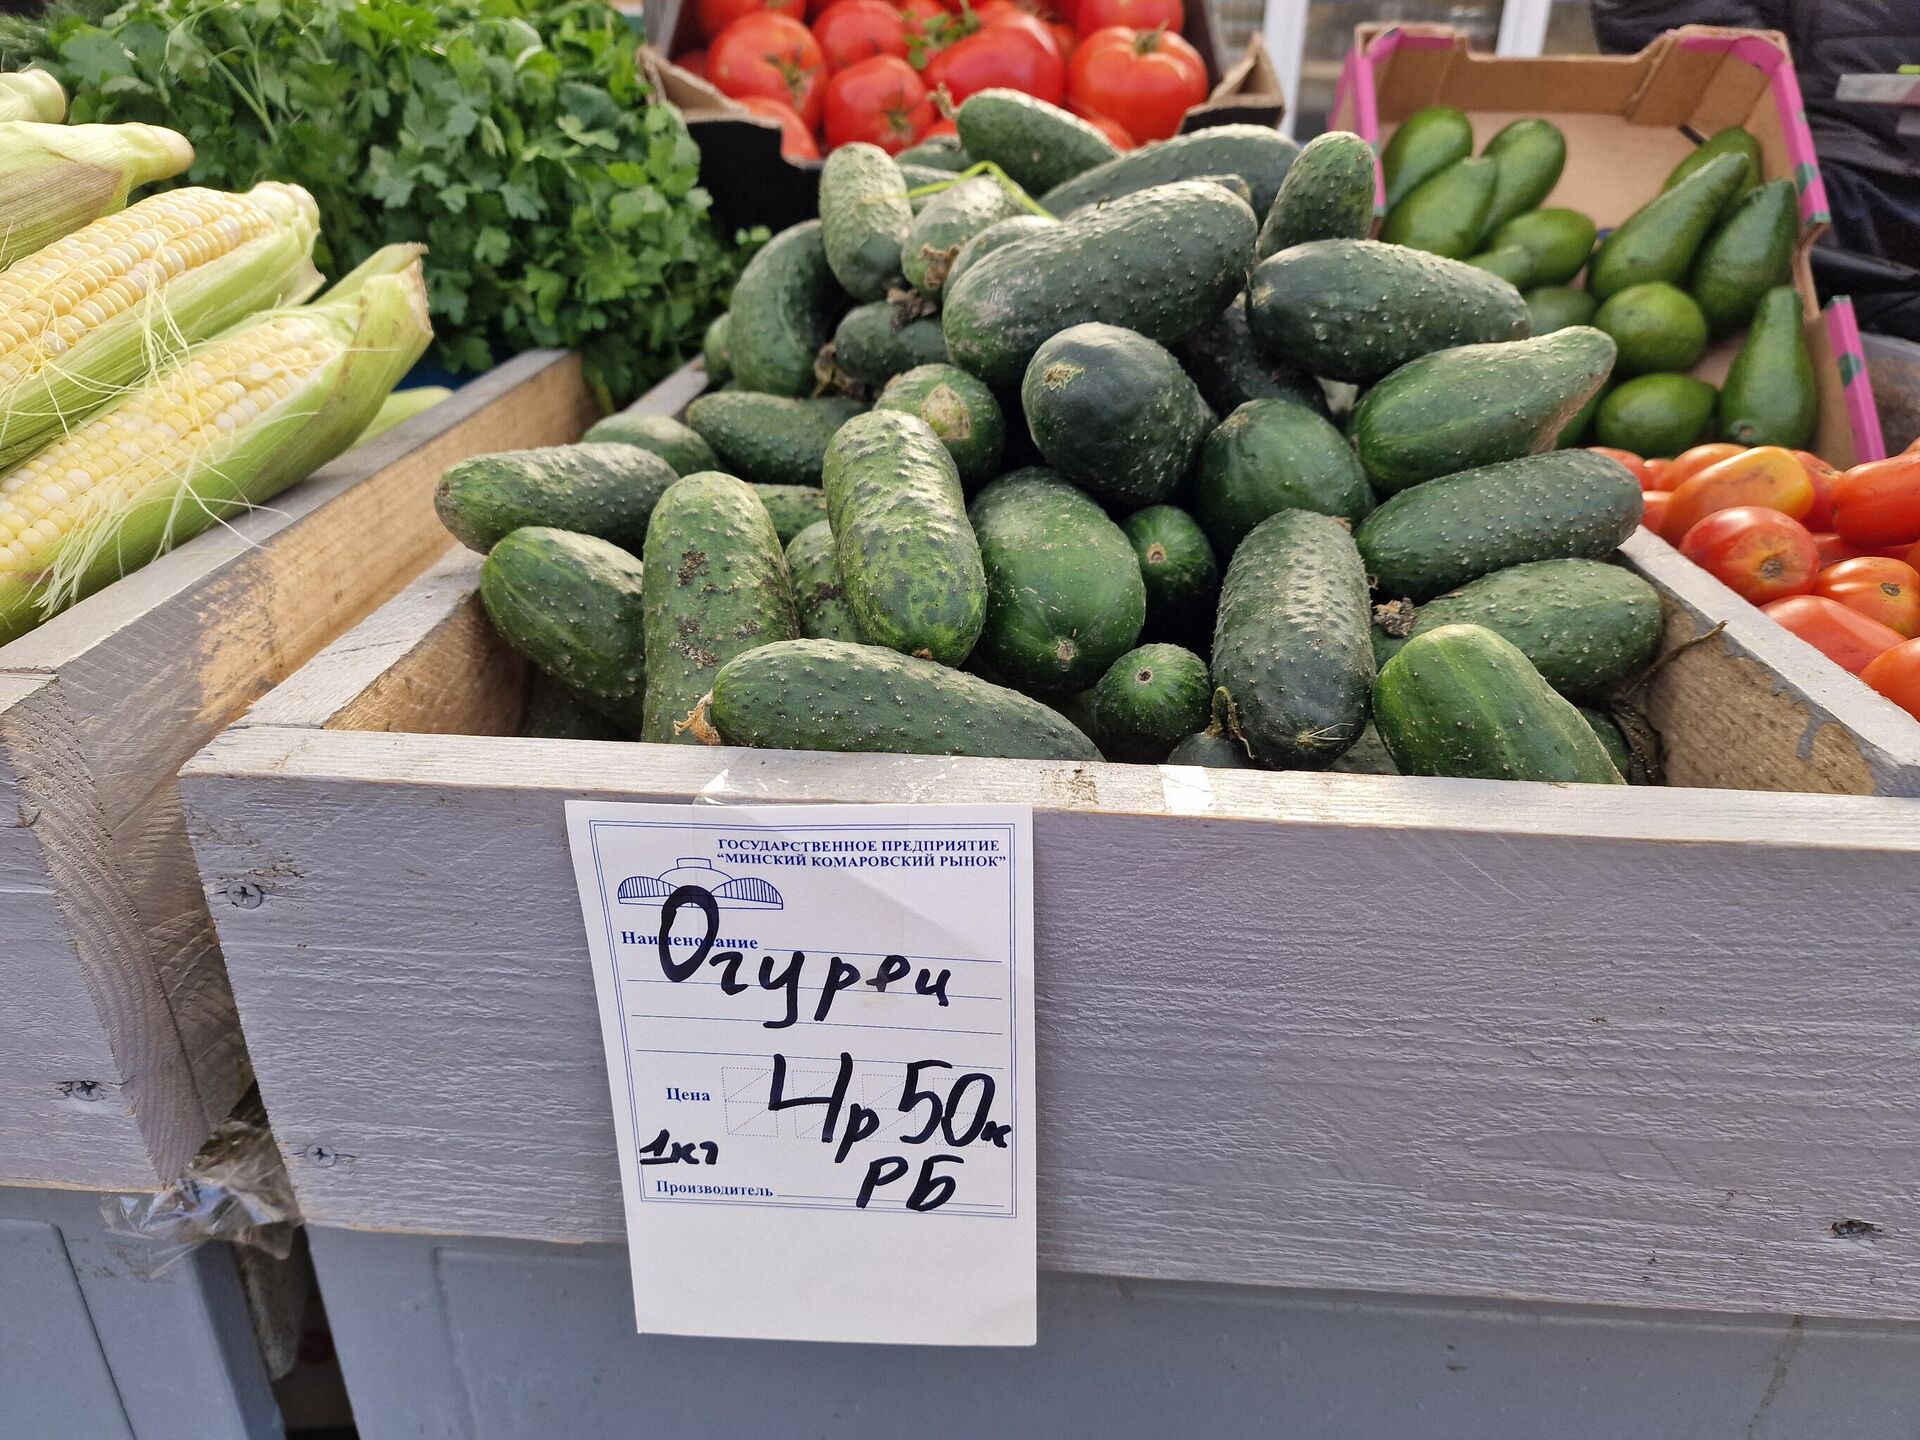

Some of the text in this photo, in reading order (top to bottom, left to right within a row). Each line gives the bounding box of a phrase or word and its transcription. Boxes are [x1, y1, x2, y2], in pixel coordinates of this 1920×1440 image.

[718, 839, 1000, 852] ГОСУДАРСТВЕННОЕ ПРЕДПРИЯТИЕ
[811, 855, 935, 868] КОМАРОВСКИЙ
[620, 931, 758, 949] Наиеноание
[665, 1086, 712, 1103] Цена
[656, 1154, 965, 1212] Производитель РБ
